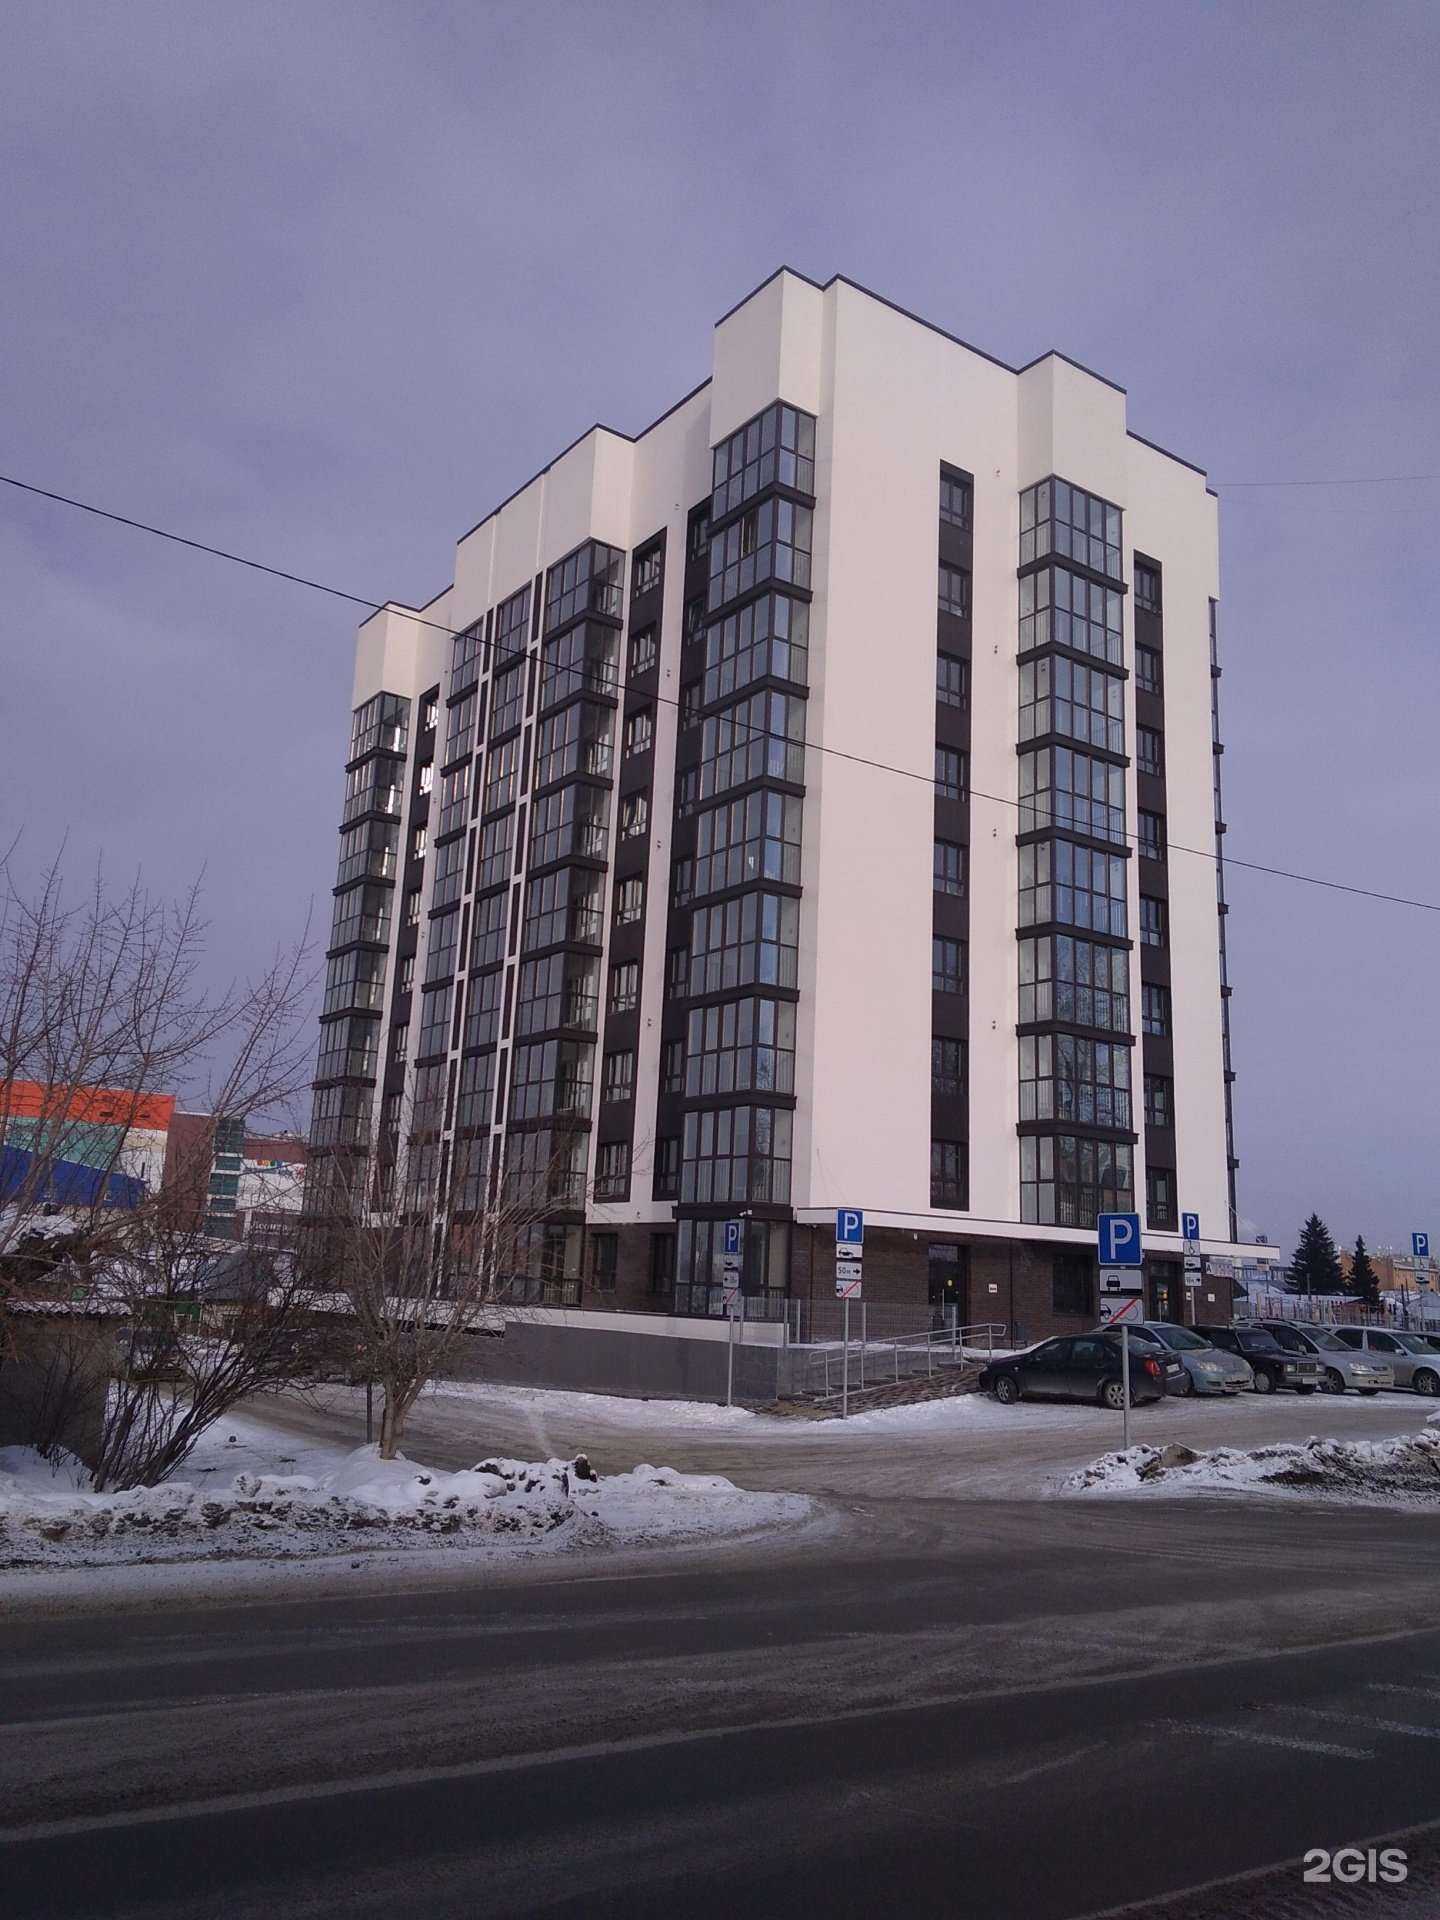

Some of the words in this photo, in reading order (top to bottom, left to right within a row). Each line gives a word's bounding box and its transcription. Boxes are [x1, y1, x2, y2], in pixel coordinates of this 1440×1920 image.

[728, 1225, 737, 1250] P
[843, 1212, 859, 1239] P
[1186, 1215, 1197, 1238] P
[1109, 1219, 1133, 1259] P
[1416, 1234, 1426, 1254] P
